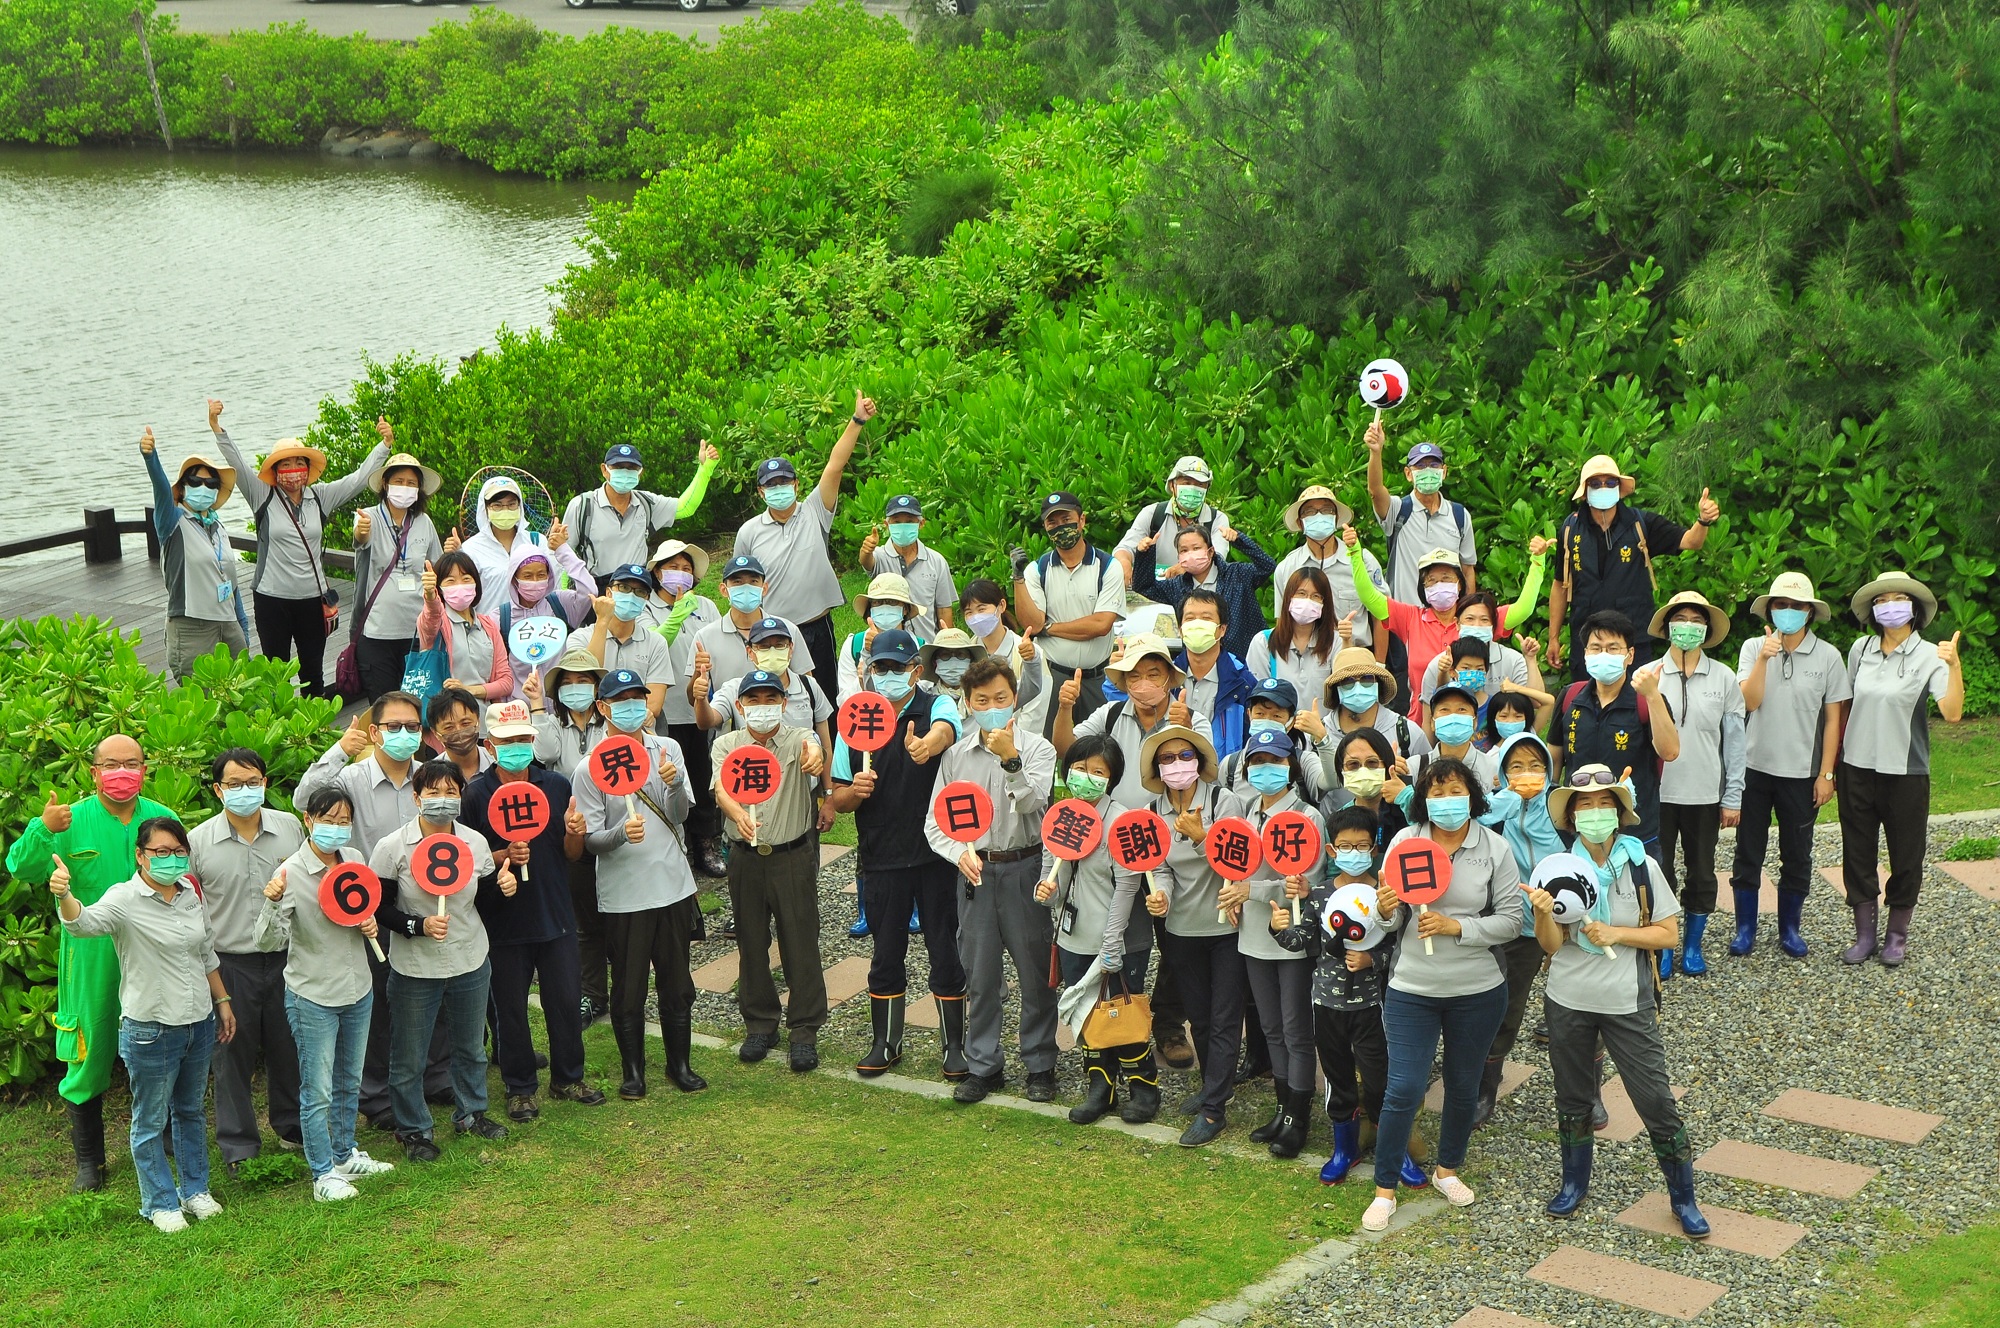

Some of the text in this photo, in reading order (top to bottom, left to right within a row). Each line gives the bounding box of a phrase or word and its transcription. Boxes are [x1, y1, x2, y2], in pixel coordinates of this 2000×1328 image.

[518, 621, 559, 641] 台江
[847, 703, 885, 740] 洋
[599, 744, 641, 788] 界
[732, 757, 772, 794] 海
[498, 793, 540, 833] 世
[945, 793, 980, 833] 日
[1048, 806, 1096, 853] 蟹
[1116, 819, 1162, 865] 謝
[1213, 828, 1250, 873] 過
[1270, 823, 1307, 863] 好
[426, 841, 459, 887] 8
[1398, 850, 1437, 893] 日
[333, 871, 370, 916] 6
